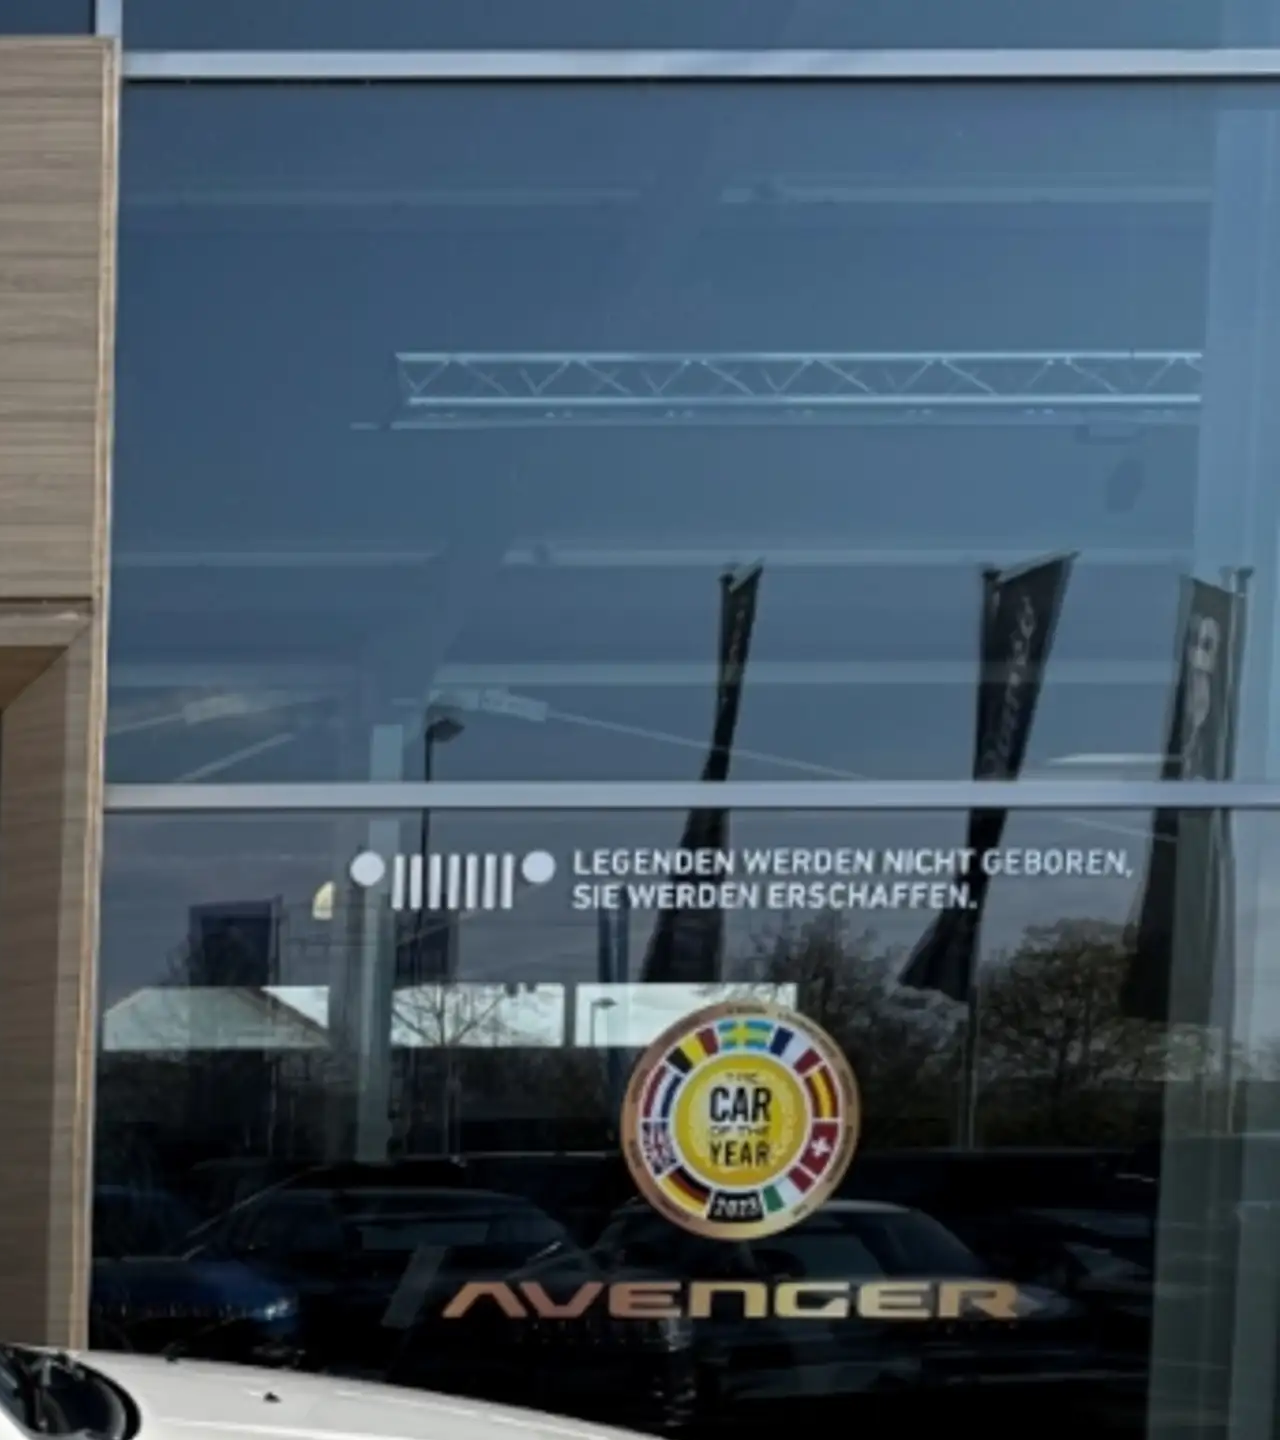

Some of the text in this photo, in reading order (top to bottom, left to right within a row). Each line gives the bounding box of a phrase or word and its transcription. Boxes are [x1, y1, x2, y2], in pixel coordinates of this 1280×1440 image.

[572, 848, 1134, 880] LEGENDEN WERDEN NICHT GEBOREN,
[572, 883, 979, 910] SIE WERDEN ERSCHAFFEN.
[709, 1086, 772, 1123] CAR
[709, 1140, 771, 1168] YEAR
[441, 1281, 1019, 1319] AVENGER
